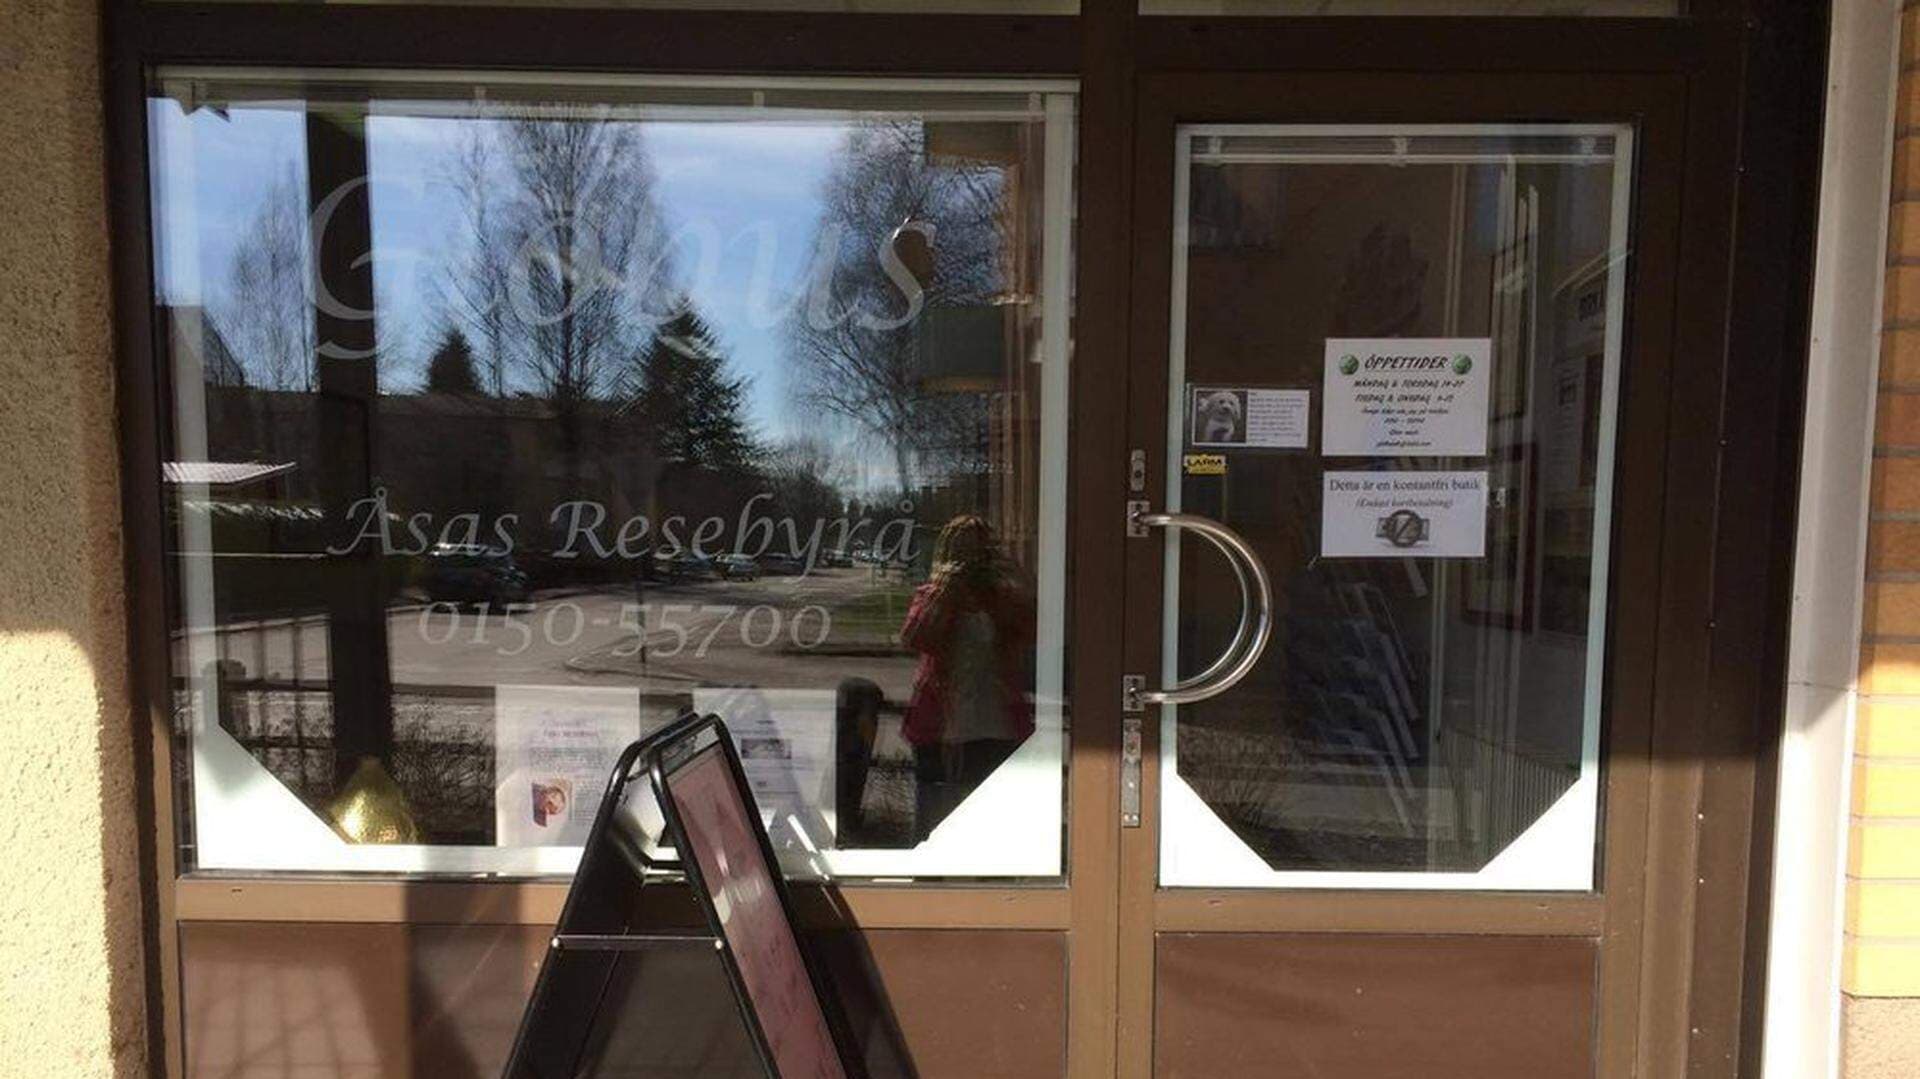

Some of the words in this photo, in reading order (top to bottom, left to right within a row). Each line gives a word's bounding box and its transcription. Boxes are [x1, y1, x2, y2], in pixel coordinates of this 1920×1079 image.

[308, 163, 937, 359] Gobus
[1364, 354, 1449, 370] ÖPPETTIDER
[1329, 479, 1359, 491] Detta
[1362, 480, 1374, 490] är
[1376, 481, 1391, 490] en
[1393, 479, 1449, 490] kontantfri
[1452, 479, 1480, 490] butik
[326, 486, 519, 556] Åsas
[550, 493, 922, 584] Resebyrå
[418, 601, 832, 658] 0150-55700
